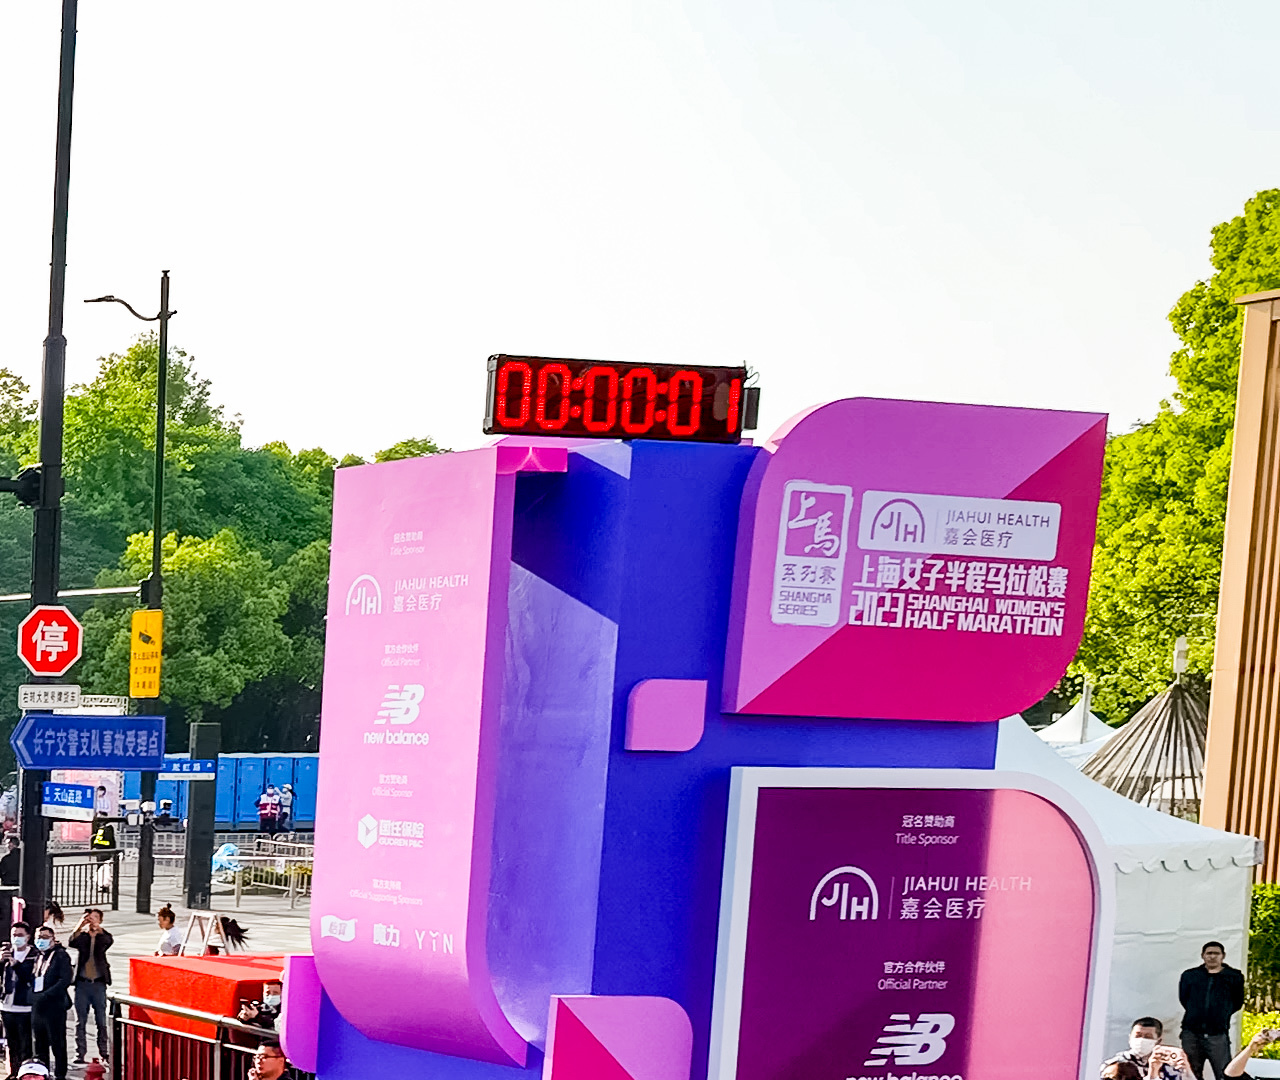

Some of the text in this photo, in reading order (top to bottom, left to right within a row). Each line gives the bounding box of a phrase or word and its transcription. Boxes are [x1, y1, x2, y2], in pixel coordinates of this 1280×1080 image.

[496, 360, 740, 436] 00:00:01
[945, 509, 1051, 528] JIAHUI HEALTH
[943, 527, 1014, 549] 嘉会医疗
[393, 574, 470, 594] JIAHUI HEALTH
[852, 554, 1070, 599] 上海女子半程马拉松赛
[392, 593, 443, 613] 嘉会医疗
[778, 590, 833, 604] SHANGMA
[906, 594, 1066, 618] SHANGHAI WOMEN'S
[777, 604, 819, 617] SERIES
[848, 589, 906, 628] 2023
[904, 610, 1064, 637] HALF MARATHON
[31, 619, 69, 662] 停
[33, 728, 160, 757] 长宁交警支队事故受理点
[363, 730, 430, 746] new balance
[53, 787, 83, 804] 天山西路
[378, 819, 425, 839] 国任保险
[901, 814, 956, 829] 冠名赞助商
[895, 832, 960, 847] Title Sponsor
[901, 876, 1033, 895] JIAHUI HEALTH
[899, 897, 987, 920] 嘉会医疗
[883, 961, 946, 974] 官方合作伙伴
[877, 978, 949, 990] Official Partner
